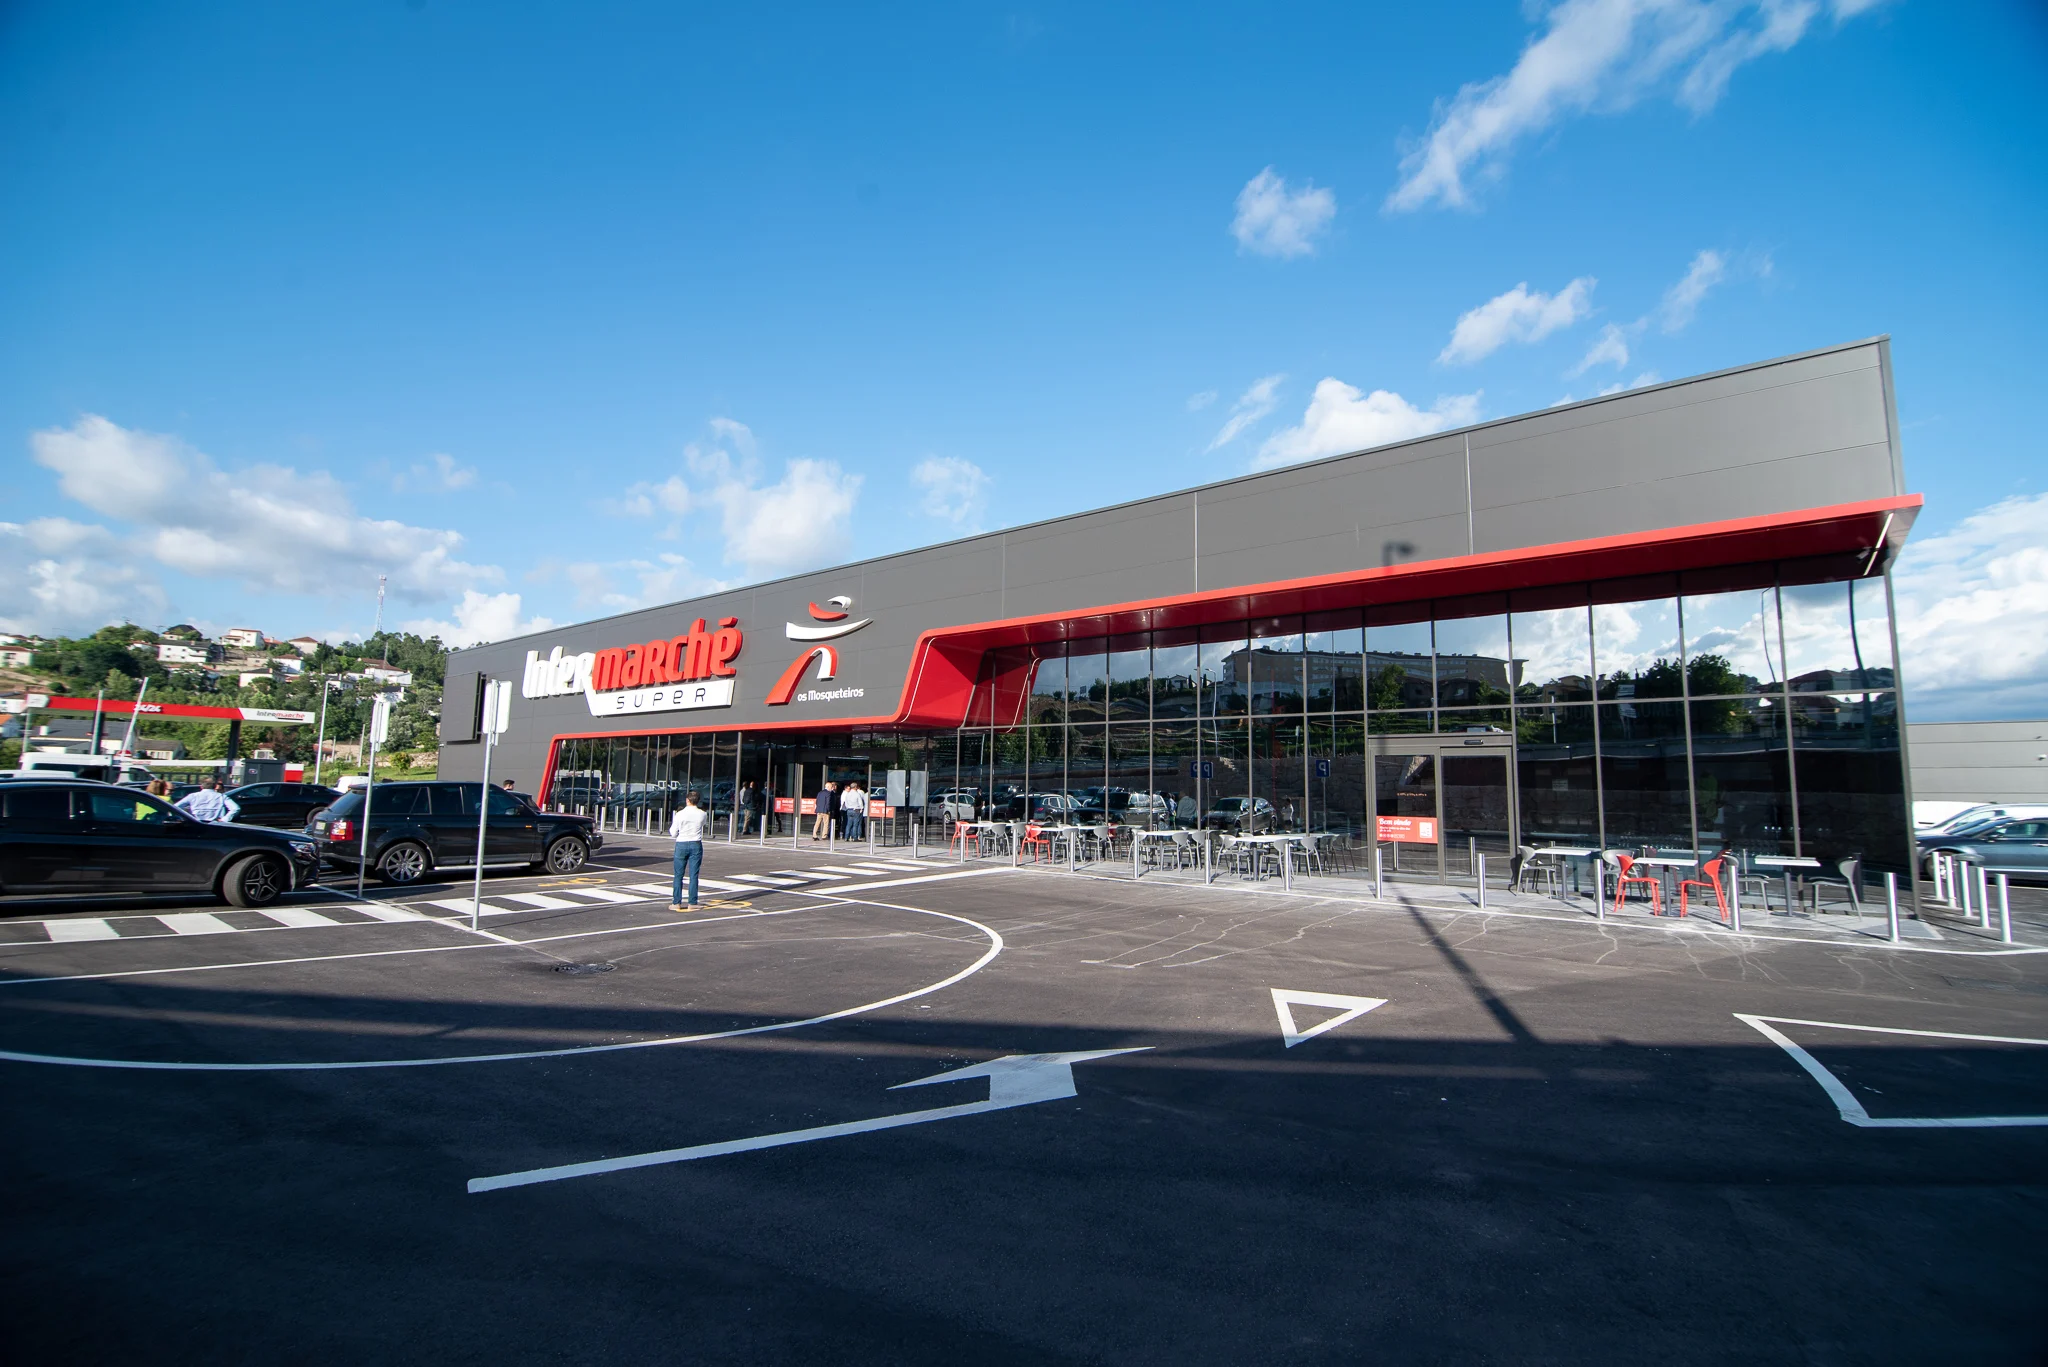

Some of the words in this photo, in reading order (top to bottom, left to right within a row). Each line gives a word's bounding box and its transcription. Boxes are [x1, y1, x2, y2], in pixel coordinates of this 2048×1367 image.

[522, 616, 743, 700] Intermarché
[616, 687, 706, 710] SUPER
[797, 693, 807, 702] os
[808, 687, 864, 702] Mosqueteiros
